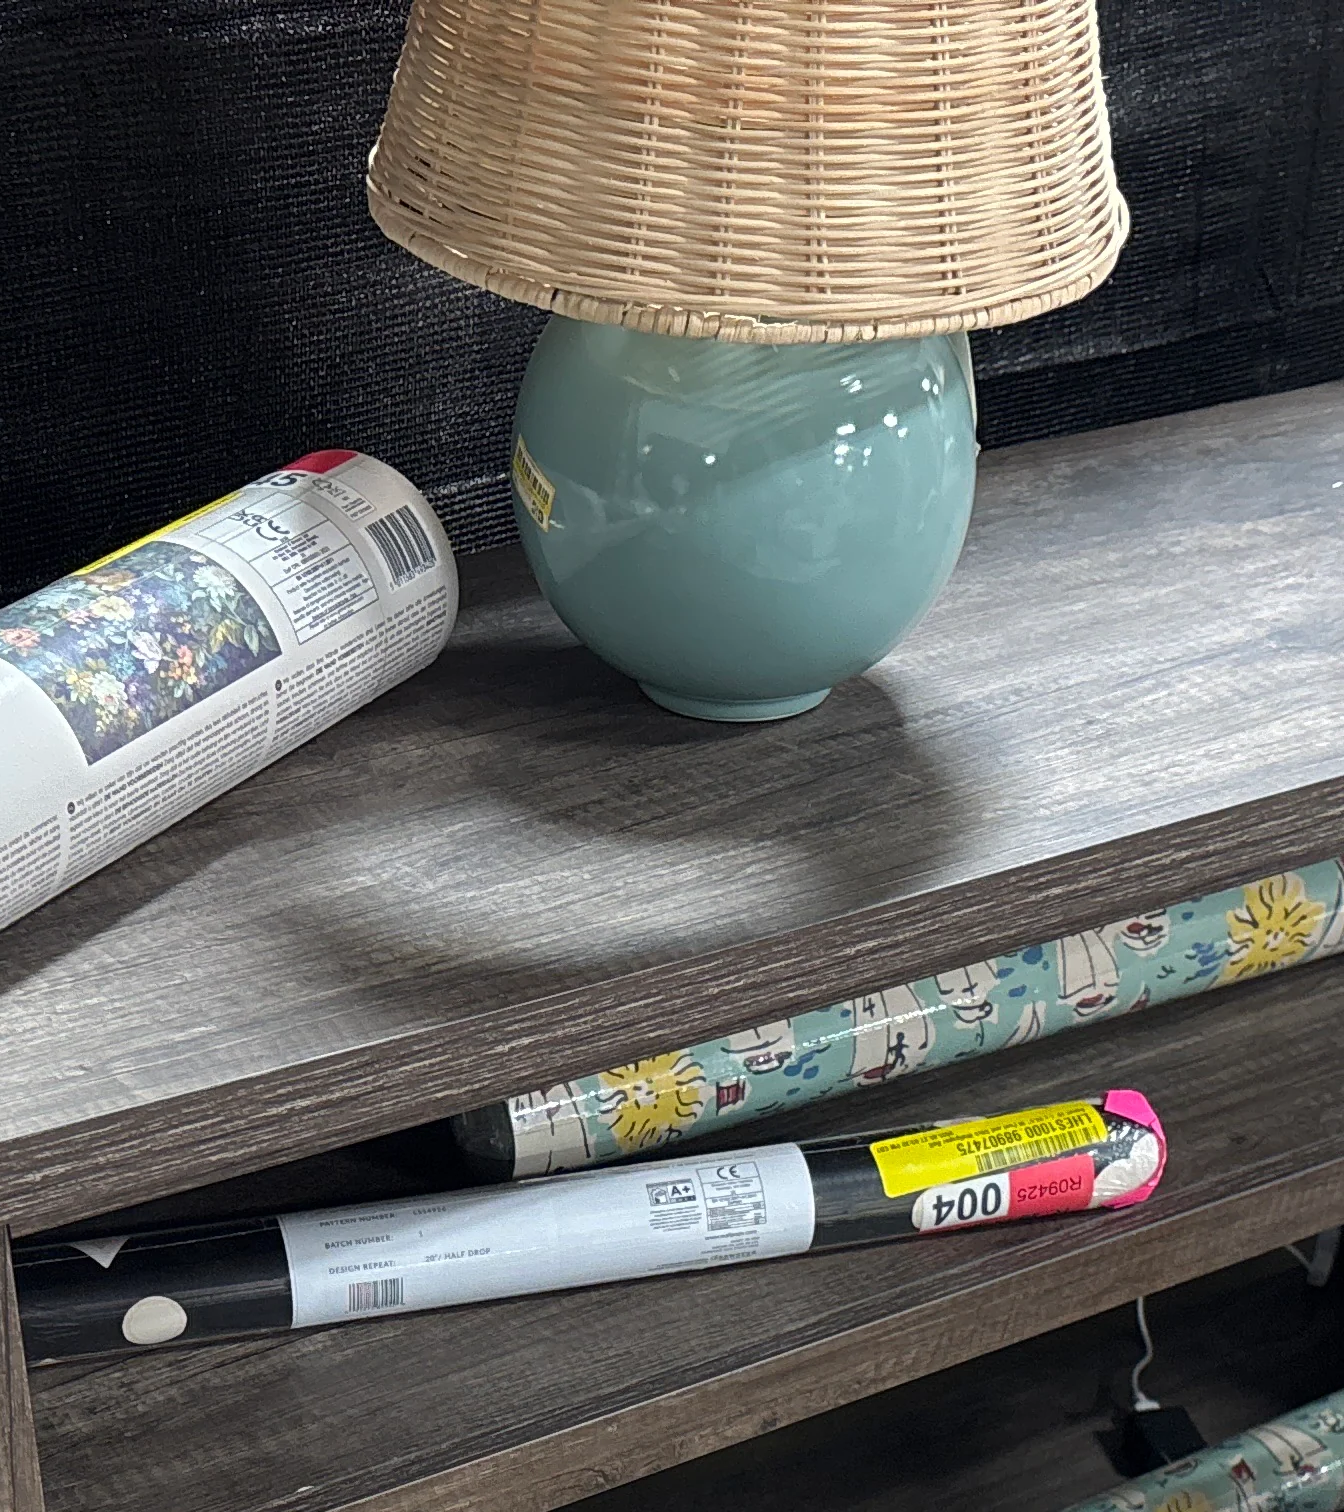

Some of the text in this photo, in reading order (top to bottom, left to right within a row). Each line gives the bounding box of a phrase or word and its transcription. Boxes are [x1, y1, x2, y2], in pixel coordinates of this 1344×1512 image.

[1025, 1113, 1091, 1137] LHES1000
[957, 1130, 1021, 1155] 98907475
[670, 1185, 690, 1196] A+
[1017, 1176, 1082, 1203] R09425
[933, 1182, 1001, 1225] 004
[320, 1218, 356, 1227] PATTERN
[325, 1239, 352, 1250] BATCH
[329, 1264, 360, 1274] DESIGN
[445, 1251, 465, 1260] HALF
[468, 1247, 491, 1257] DROP
